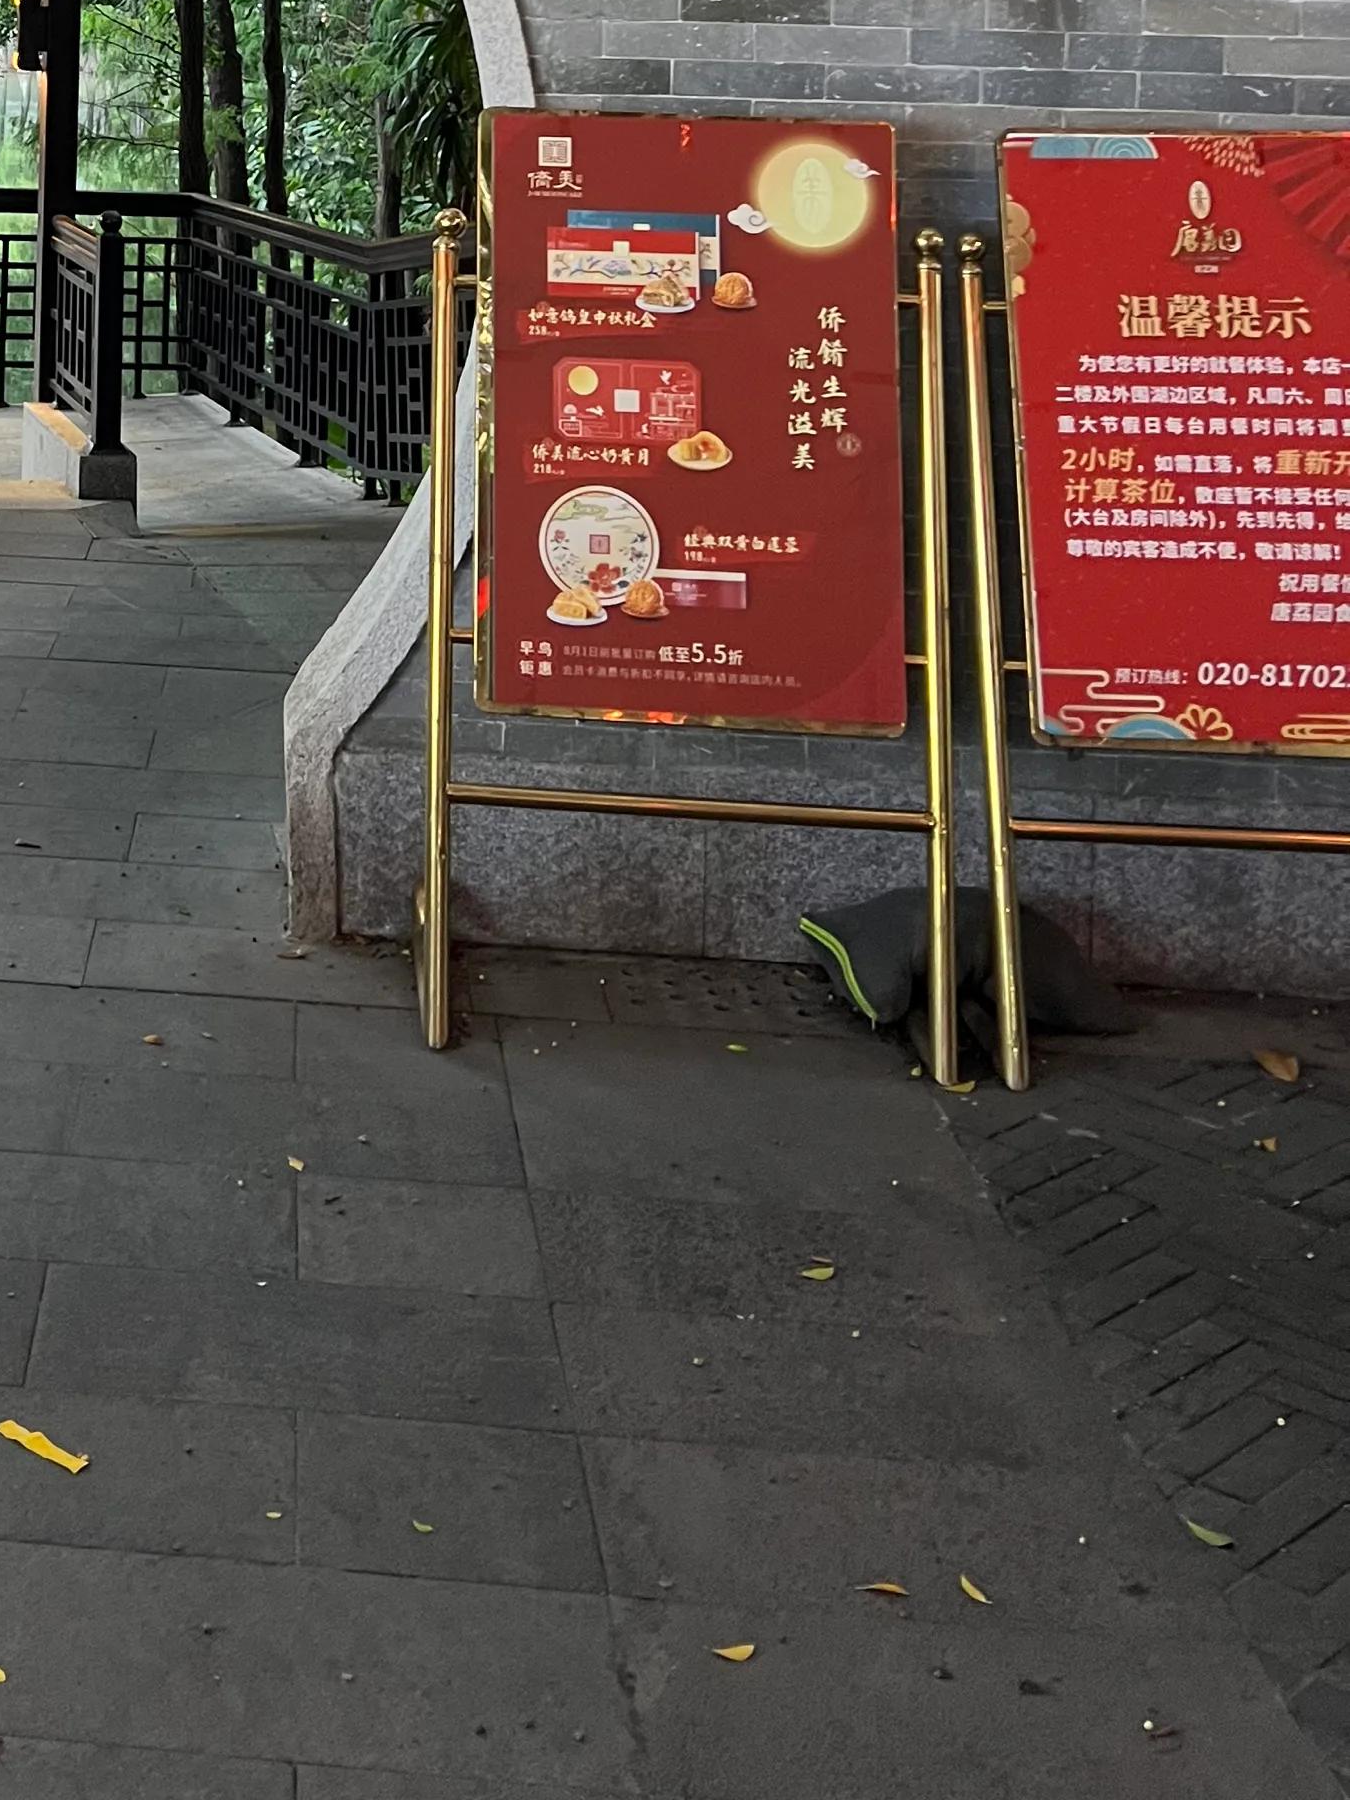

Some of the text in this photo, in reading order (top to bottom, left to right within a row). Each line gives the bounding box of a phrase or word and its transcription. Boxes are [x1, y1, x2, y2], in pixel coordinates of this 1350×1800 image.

[1117, 293, 1313, 339] 温馨提示
[788, 347, 818, 470] 流光溢美
[519, 640, 554, 657] 早鸟
[658, 642, 744, 667] 低至5.5折
[1197, 661, 1350, 689] 020-81702
